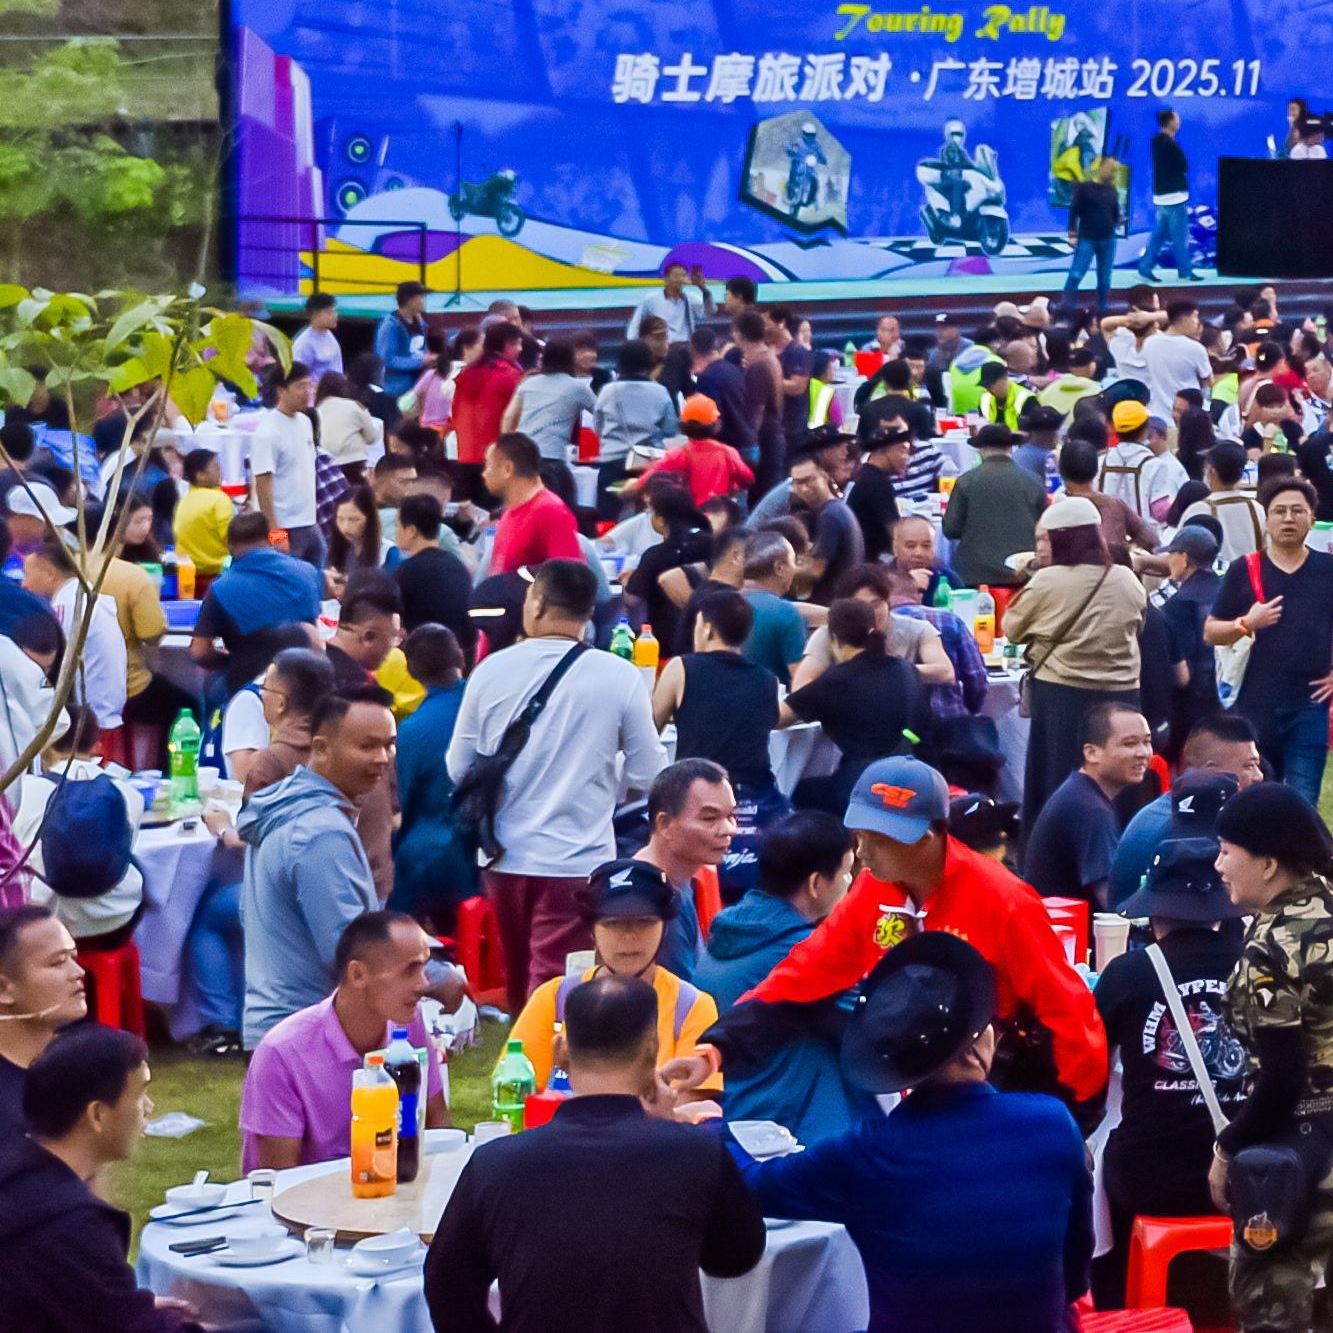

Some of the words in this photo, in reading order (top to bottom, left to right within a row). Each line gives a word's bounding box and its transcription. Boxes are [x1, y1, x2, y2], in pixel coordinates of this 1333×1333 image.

[834, 3, 964, 43] Touring
[975, 4, 1066, 42] Rally
[1126, 58, 1262, 98] 2025.11
